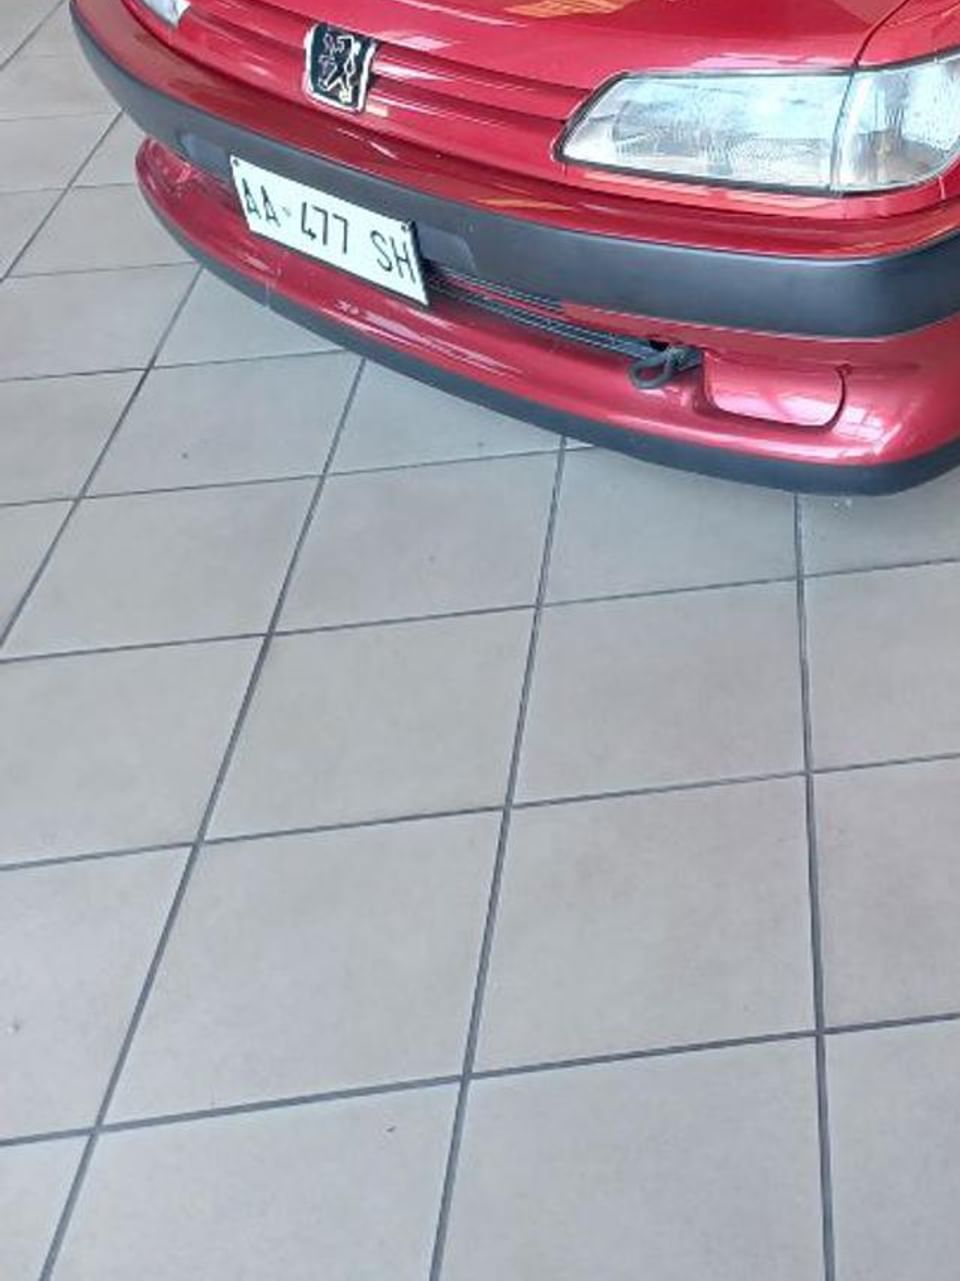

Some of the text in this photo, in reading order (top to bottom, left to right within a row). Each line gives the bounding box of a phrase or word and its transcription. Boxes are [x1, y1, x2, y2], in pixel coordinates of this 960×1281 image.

[242, 178, 416, 284] AA 477 SH
